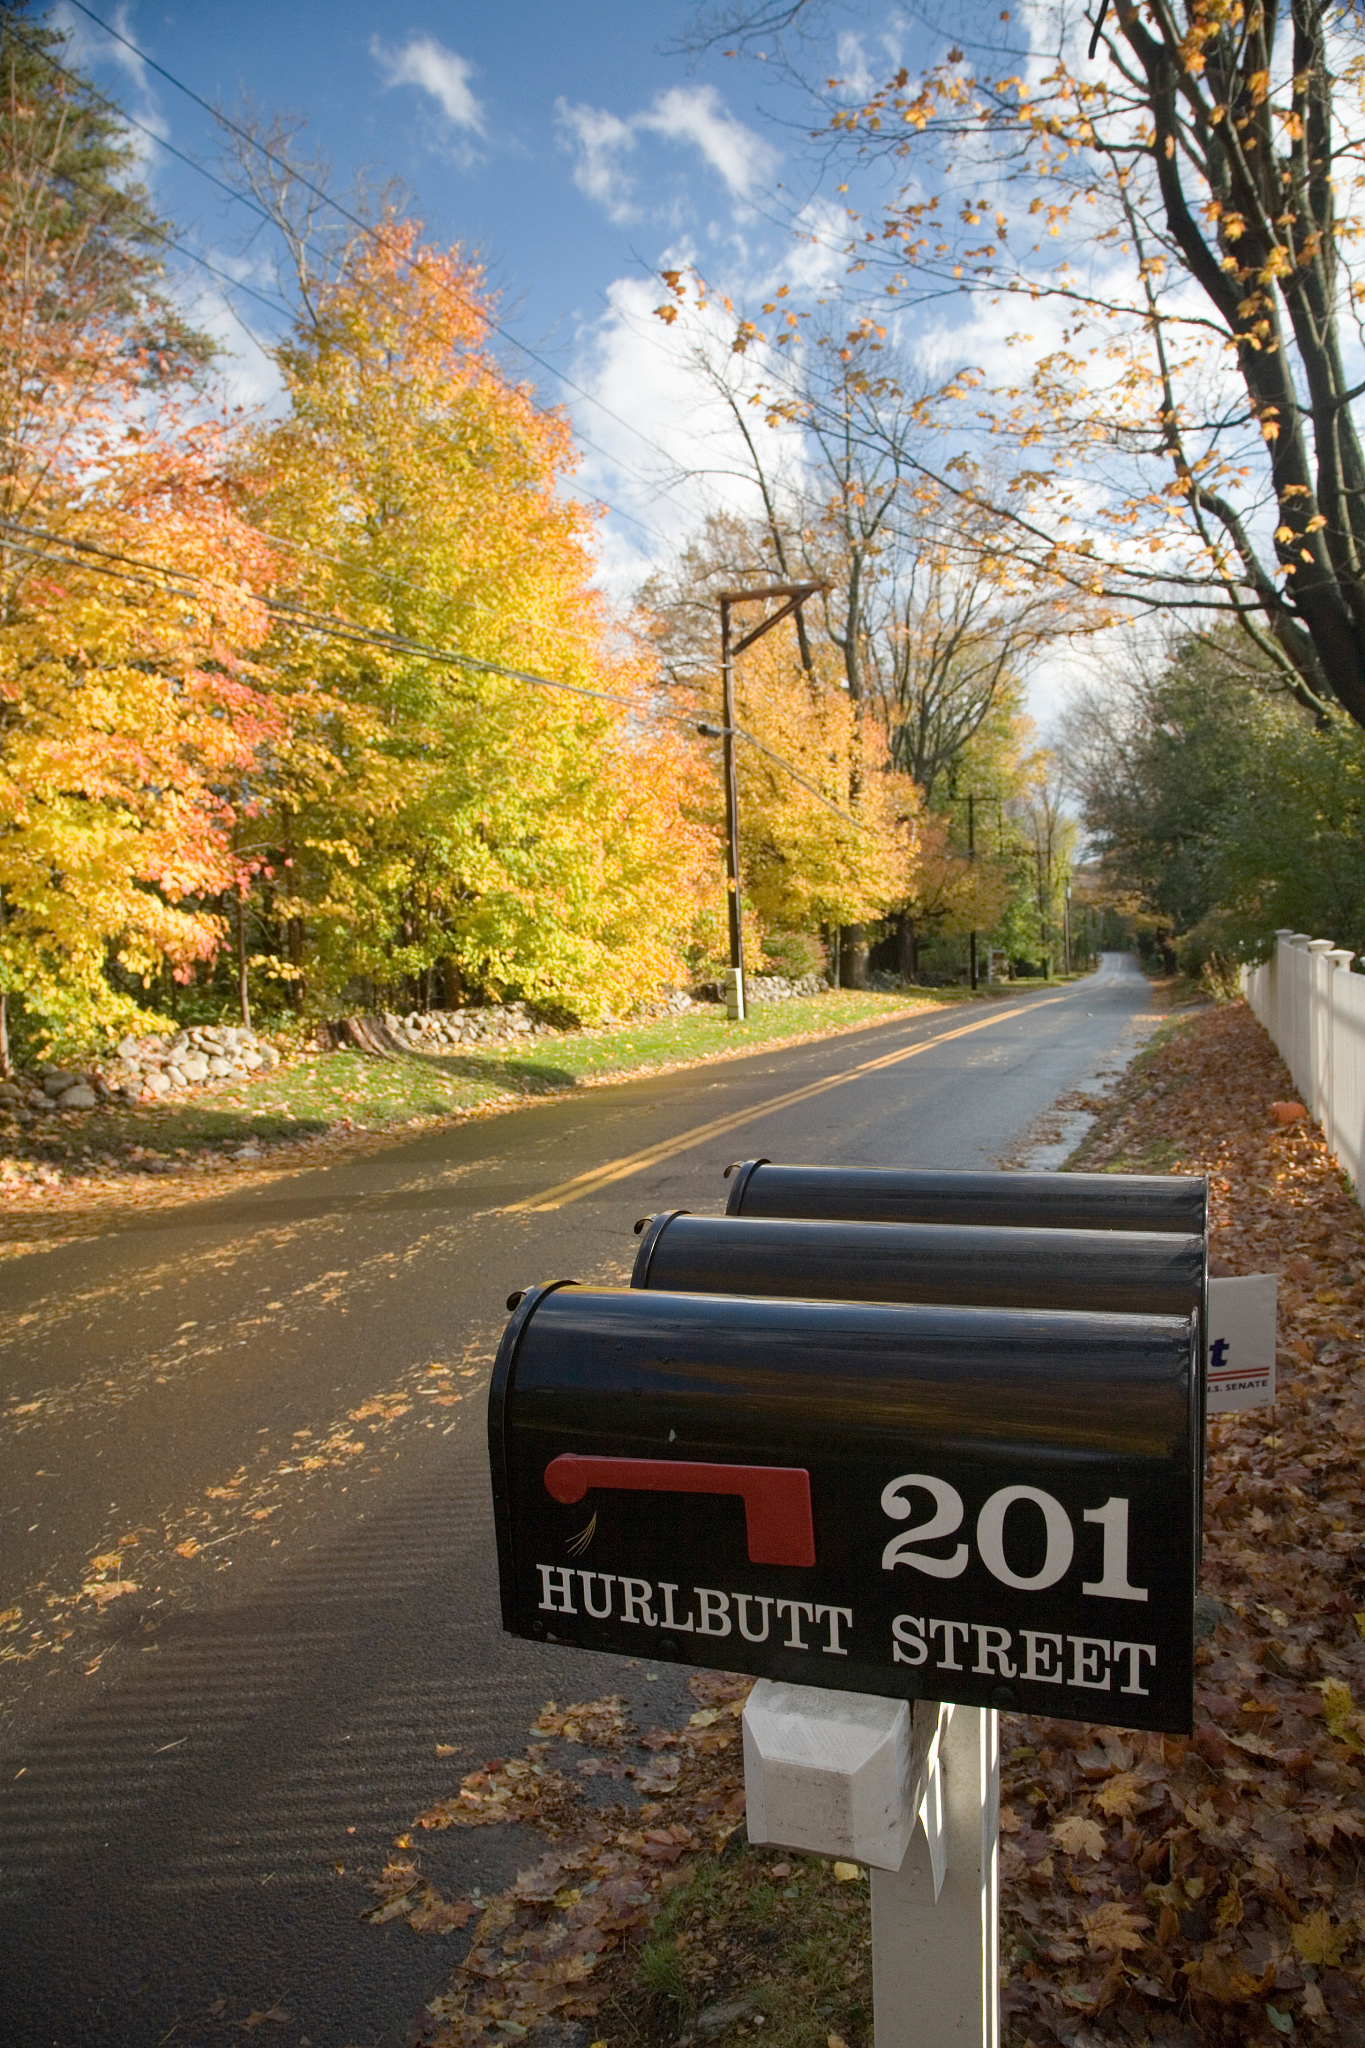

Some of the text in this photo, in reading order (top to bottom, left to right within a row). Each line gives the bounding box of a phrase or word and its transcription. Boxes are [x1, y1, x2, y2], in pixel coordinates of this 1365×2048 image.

[1225, 1380, 1268, 1391] SENATE
[881, 1474, 1148, 1602] 201
[536, 1563, 1156, 1695] HURLBUTT STREET
